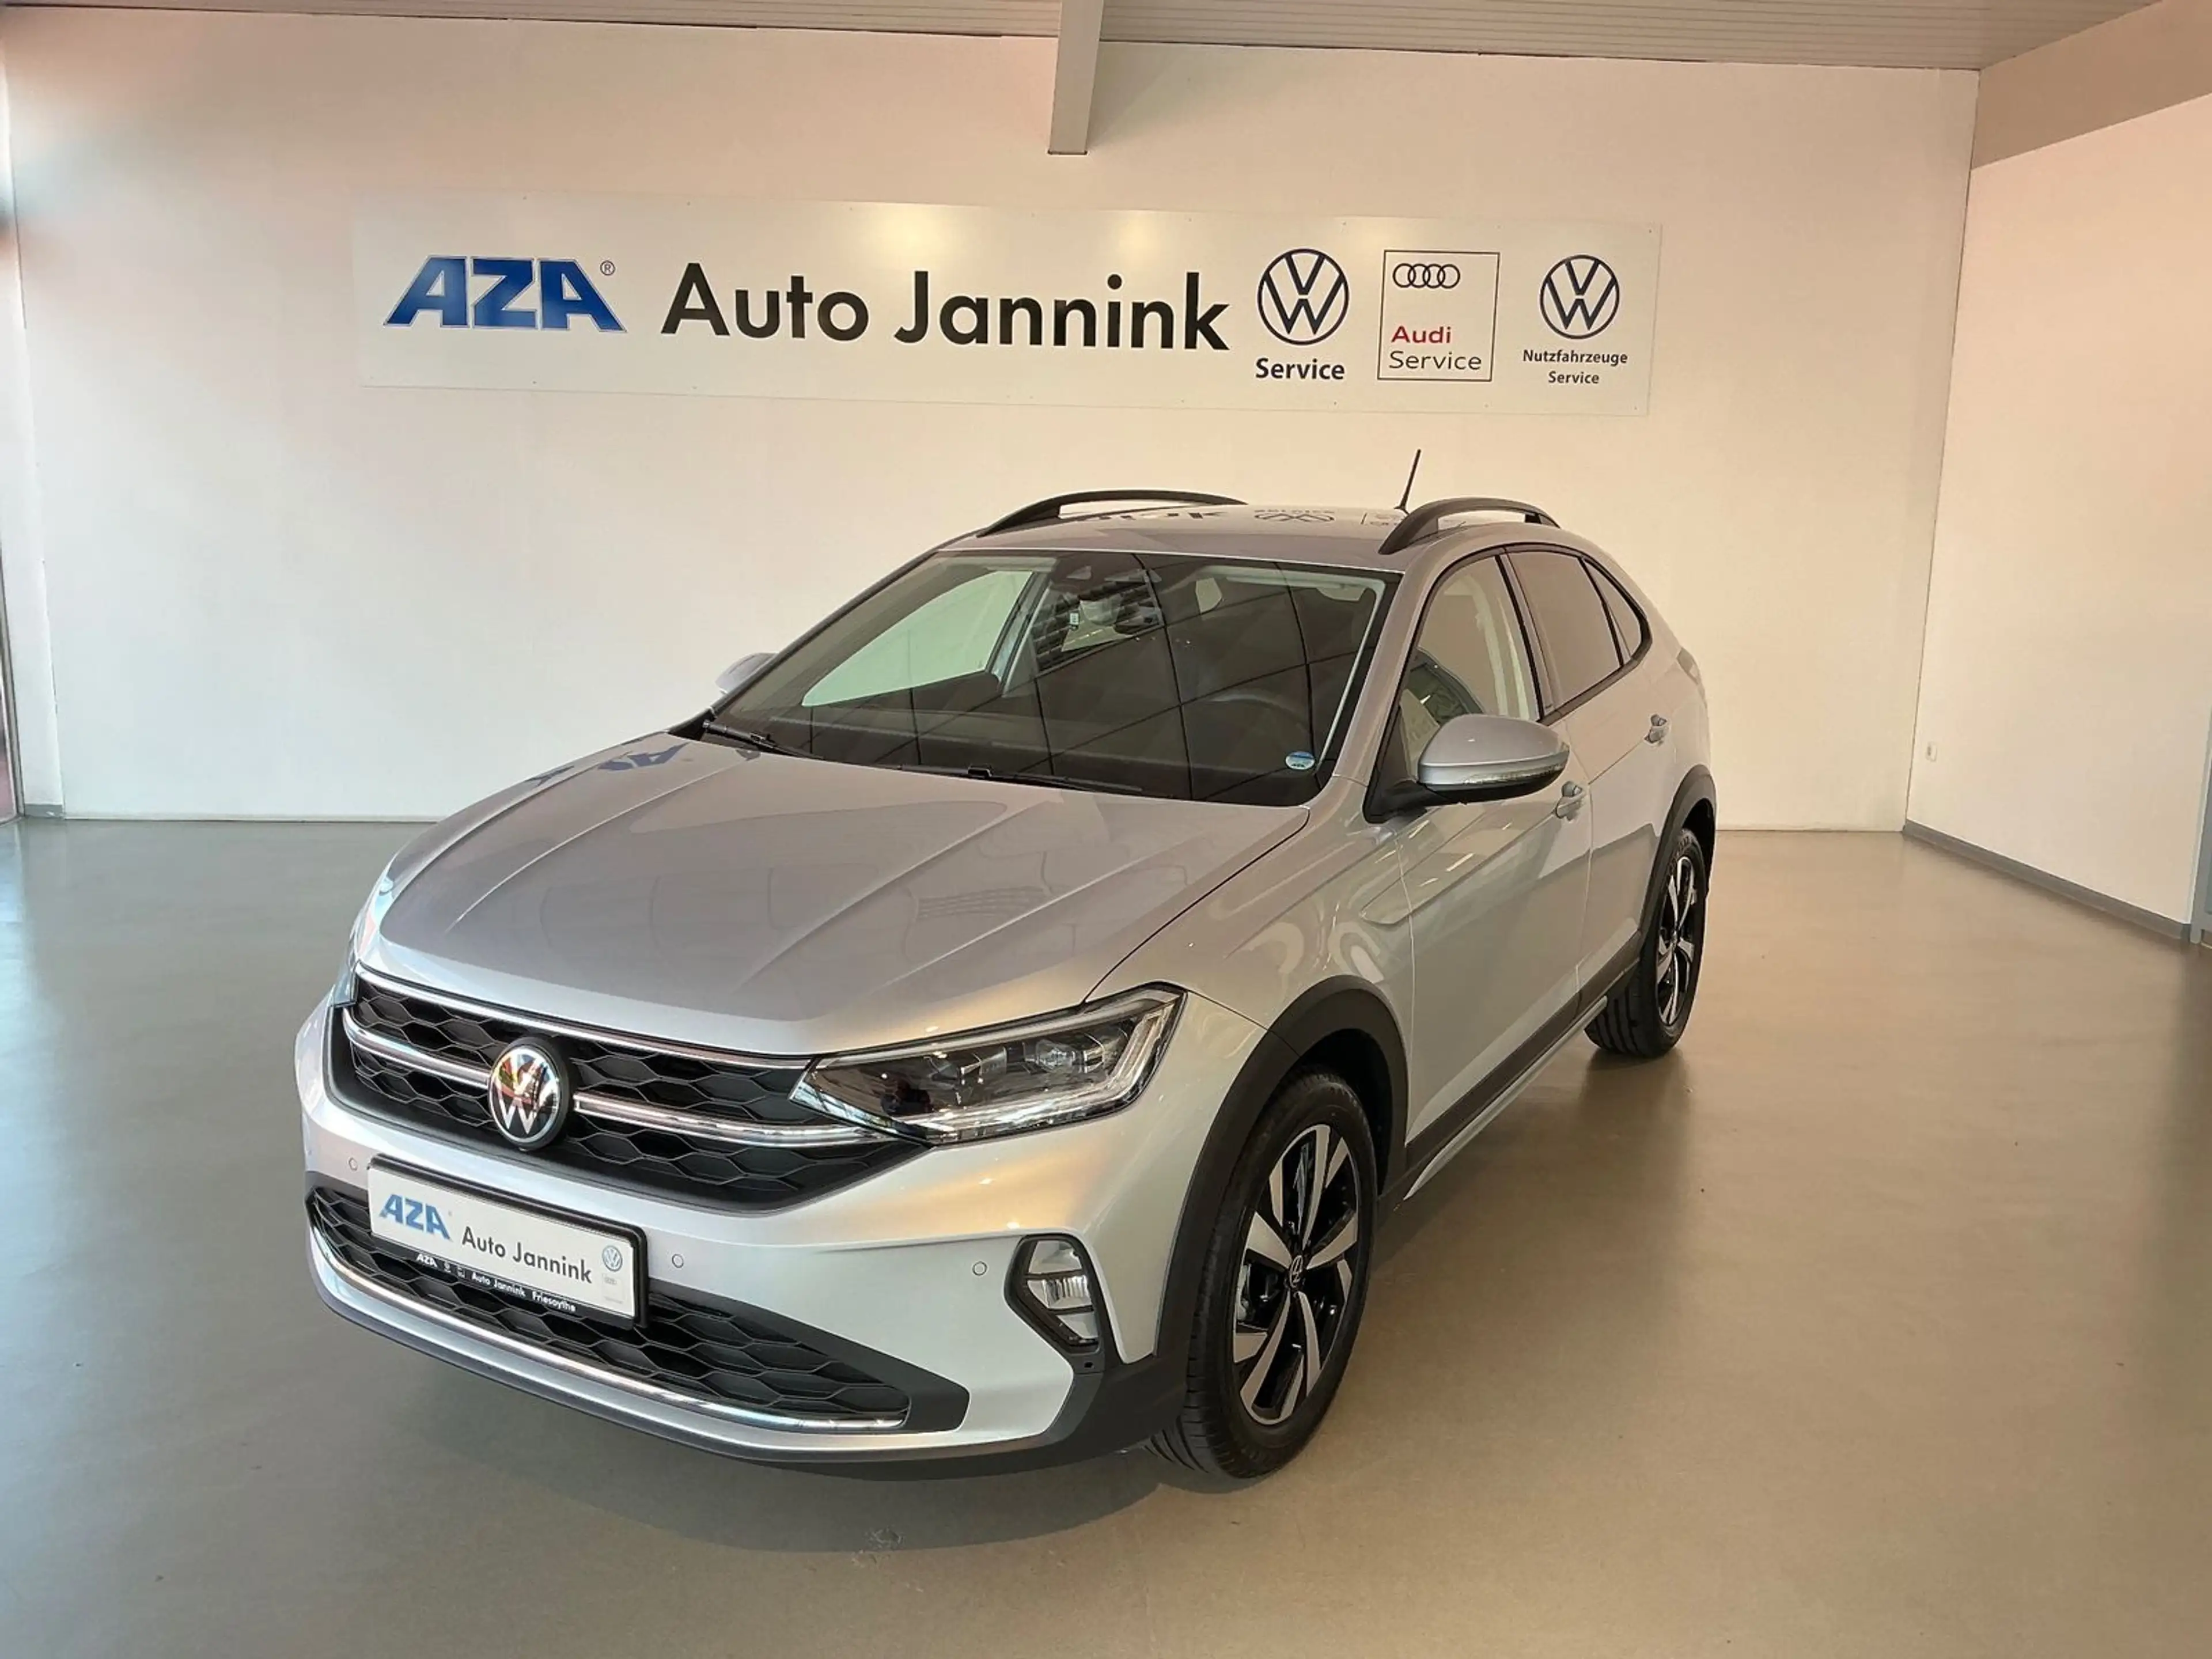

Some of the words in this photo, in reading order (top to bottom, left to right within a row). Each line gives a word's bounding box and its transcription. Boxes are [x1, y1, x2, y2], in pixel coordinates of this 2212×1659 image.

[661, 263, 869, 342] Auto
[893, 270, 1231, 351] Jannink
[1391, 325, 1452, 344] Audi
[1255, 357, 1345, 381] Service
[1389, 350, 1482, 371] Service
[1522, 349, 1628, 366] Nutzfahrzeuge
[1548, 370, 1600, 385] Service
[378, 1194, 453, 1242] AZA
[461, 1226, 506, 1258] Auto
[513, 1242, 593, 1284] Jannink
[471, 1271, 491, 1286] Auto
[493, 1278, 527, 1297] Jannink
